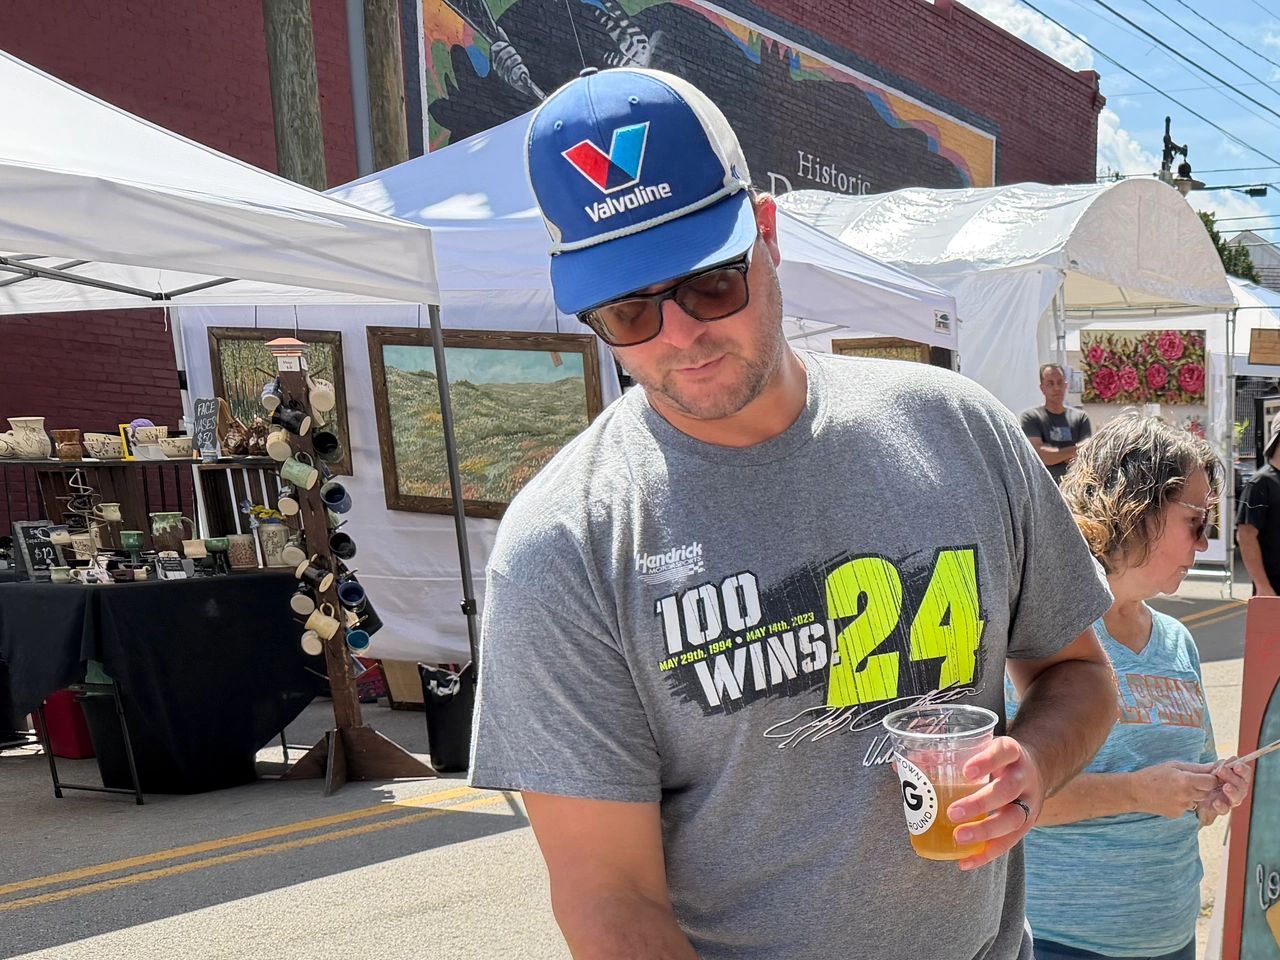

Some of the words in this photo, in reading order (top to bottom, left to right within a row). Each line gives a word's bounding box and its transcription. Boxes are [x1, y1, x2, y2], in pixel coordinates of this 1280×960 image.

[797, 150, 871, 196] Historic
[584, 182, 673, 223] Valvoline
[197, 401, 216, 417] FACE
[635, 541, 703, 573] Hendrick
[648, 556, 703, 575] MOTORSPORTS
[656, 572, 763, 655] 100
[825, 549, 985, 711] 24
[659, 659, 679, 672] MAY
[708, 638, 733, 656] 1994
[746, 627, 767, 642] MAY
[791, 611, 815, 627] 2023
[694, 619, 841, 708] WINS!
